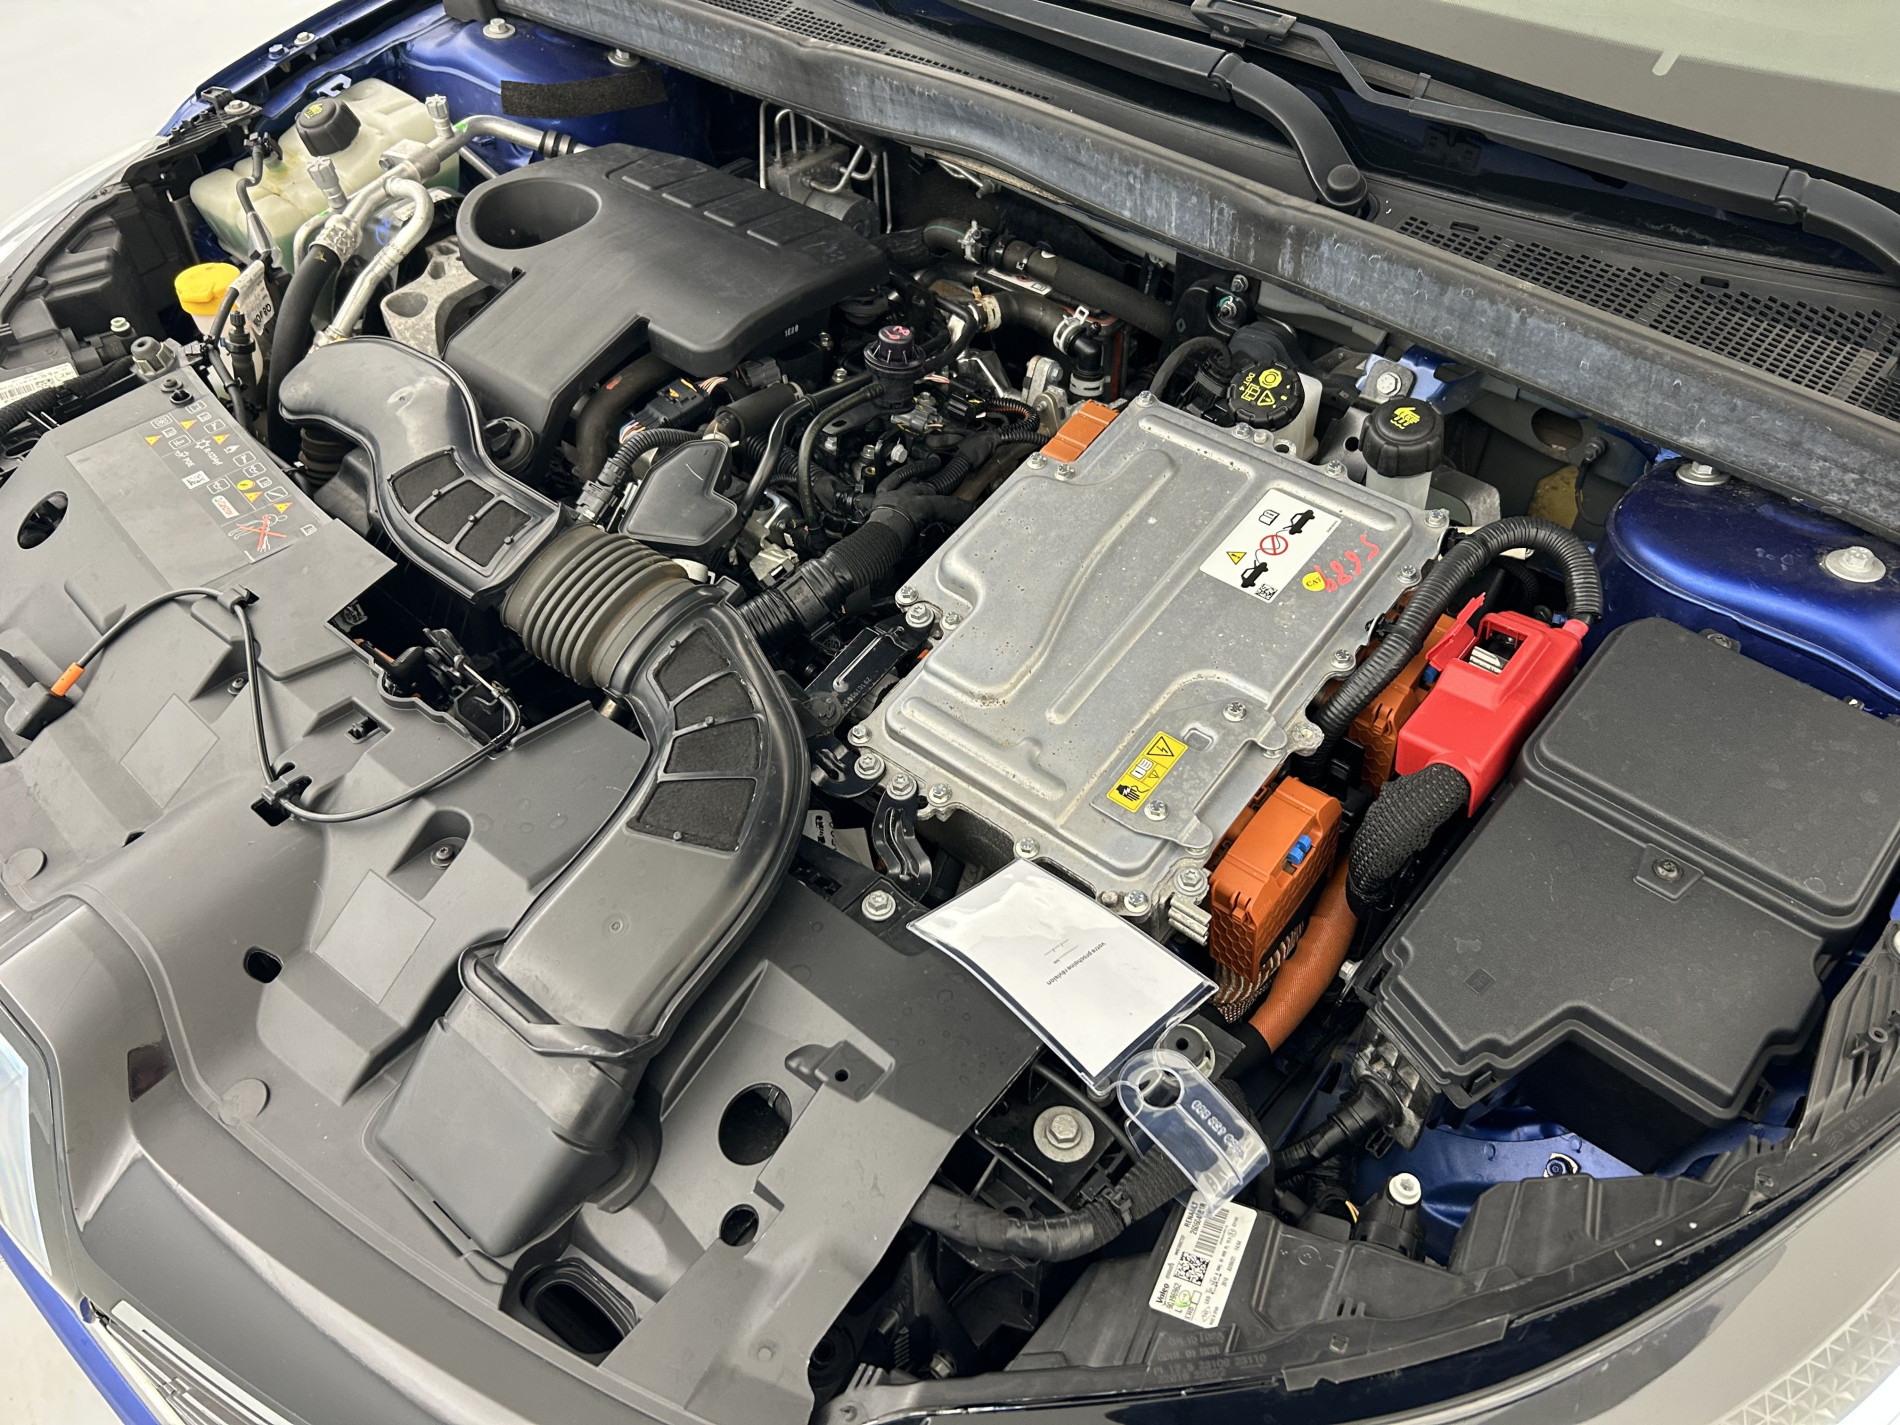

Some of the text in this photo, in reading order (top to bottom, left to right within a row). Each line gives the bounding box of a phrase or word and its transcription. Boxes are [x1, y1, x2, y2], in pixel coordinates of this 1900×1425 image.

[1243, 372, 1256, 386] DOT
[1046, 941, 1107, 986] votre prochaine révision
[1184, 1201, 1199, 1228] RENAULT
[1156, 1283, 1170, 1304] Valeo
